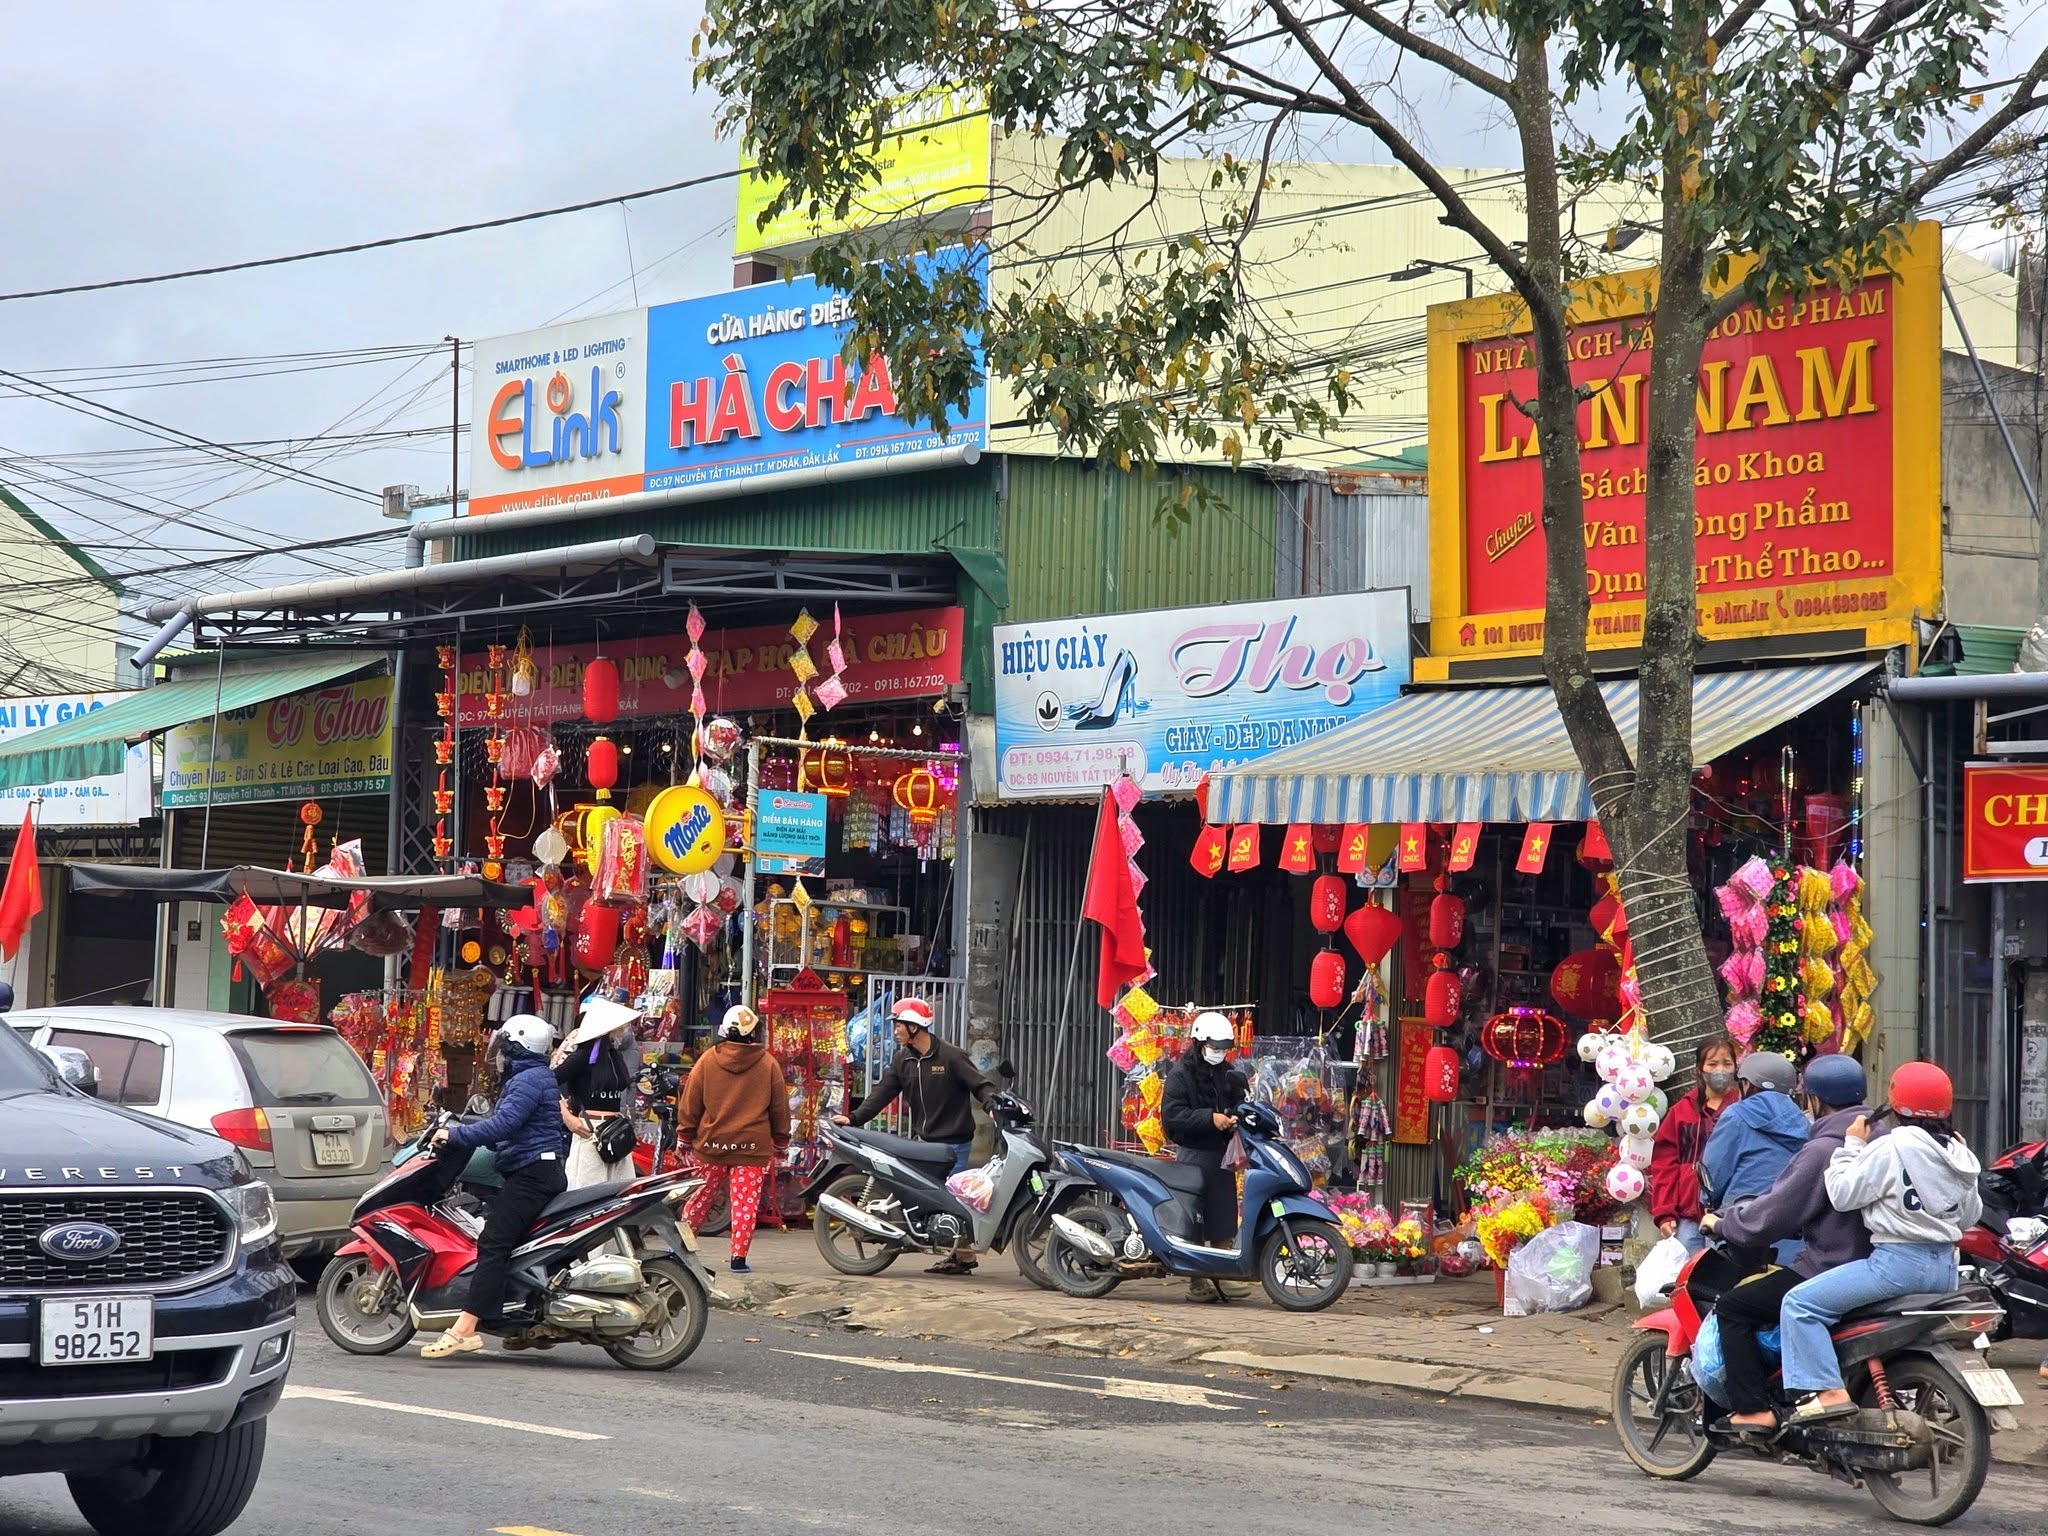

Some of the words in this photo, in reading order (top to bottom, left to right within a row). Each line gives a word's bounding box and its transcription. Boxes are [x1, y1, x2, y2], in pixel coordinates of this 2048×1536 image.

[707, 313, 746, 345] CỬA
[749, 305, 805, 336] HÀNG
[495, 353, 551, 375] SMARTHOME
[553, 351, 560, 364] &
[563, 348, 579, 362] LED
[583, 338, 626, 358] LIGHTING
[1695, 338, 1880, 434] NAM
[669, 353, 761, 449] HÀ
[855, 447, 868, 459] ĐT:
[870, 445, 889, 457] 0914
[891, 442, 905, 454] 167
[906, 440, 922, 451] 702
[963, 431, 980, 443] 702
[663, 476, 673, 487] 97
[674, 469, 706, 485] NGUYỄN
[709, 465, 722, 479] TẤT
[1737, 450, 1825, 482] Khoa
[501, 487, 611, 513] www.elink.com.vn
[1581, 515, 1637, 549] Văn
[1752, 487, 1851, 531] Phẩm
[1484, 509, 1537, 560] Chuyên
[1711, 540, 1774, 584] Thể
[1777, 543, 1886, 577] Thao...
[868, 622, 947, 663] CHÂU
[1482, 626, 1504, 646] 101
[1001, 630, 1050, 682] HIỆU
[1055, 625, 1108, 669] GIÀY
[1168, 615, 1388, 707] Thọ
[776, 687, 791, 699] ĐT:
[874, 674, 944, 692] 0918.167.702
[25, 699, 50, 728] LÝ
[312, 687, 390, 746] Thoa
[477, 710, 487, 720] 97
[1165, 719, 1212, 754] GIÀY
[1267, 720, 1296, 748] DA
[169, 769, 203, 788] Chuyên
[235, 765, 254, 782] Bán
[270, 763, 277, 779] &
[296, 759, 315, 777] Các
[318, 758, 340, 778] Loại
[369, 754, 389, 774] Đậu
[1009, 752, 1032, 767] ĐT:
[1036, 746, 1136, 764] 0934.71.98.38
[333, 781, 362, 792] 0935.39
[364, 780, 374, 791] 75
[375, 779, 386, 790] 57
[1009, 774, 1025, 786] ĐC:
[1027, 773, 1038, 784] 99
[1040, 764, 1078, 784] NGUYỄN
[664, 804, 713, 859] Monte
[762, 812, 780, 825] ĐIỂM
[782, 815, 799, 826] BÁN
[800, 817, 824, 828] HÀNG
[321, 1149, 350, 1163] 493.20
[703, 1141, 756, 1151] AMADUS
[62, 1229, 104, 1251] Ford
[73, 1303, 122, 1329] 51H
[54, 1331, 140, 1360] 982.52
